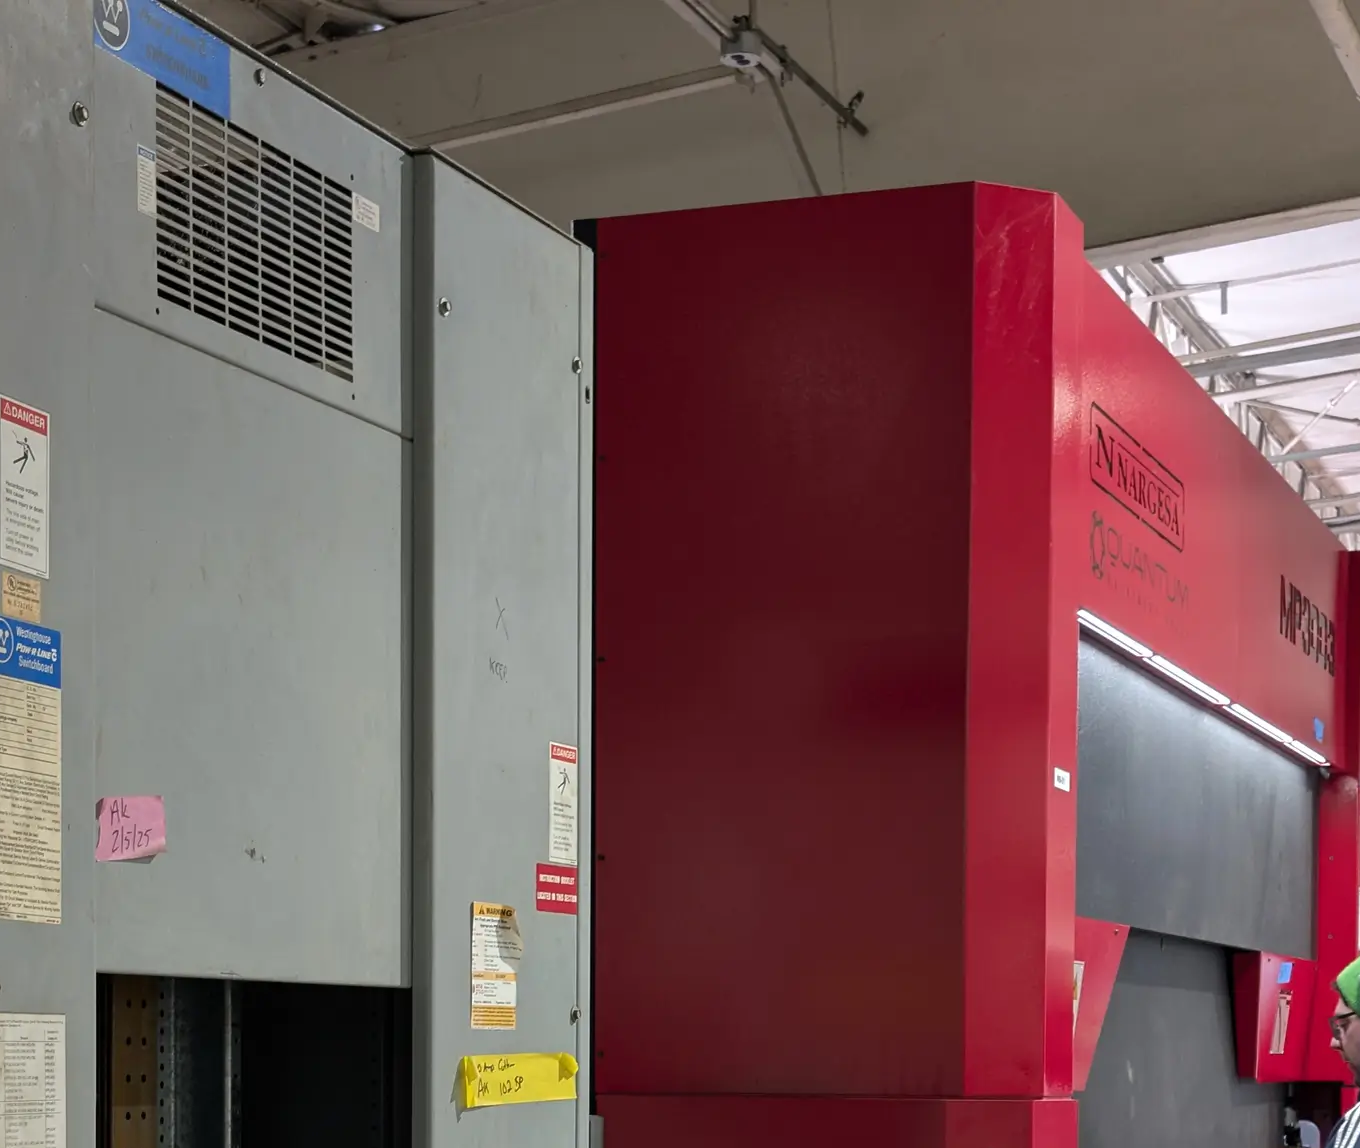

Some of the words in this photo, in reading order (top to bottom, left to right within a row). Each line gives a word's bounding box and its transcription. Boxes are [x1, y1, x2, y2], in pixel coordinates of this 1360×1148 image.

[11, 406, 46, 429] DANGER
[1116, 450, 1181, 537] NARGESA
[1107, 526, 1189, 604] QUANTUM
[15, 626, 52, 645] Westinghouse
[18, 655, 54, 674] Switchboard
[486, 907, 513, 917] WARNING
